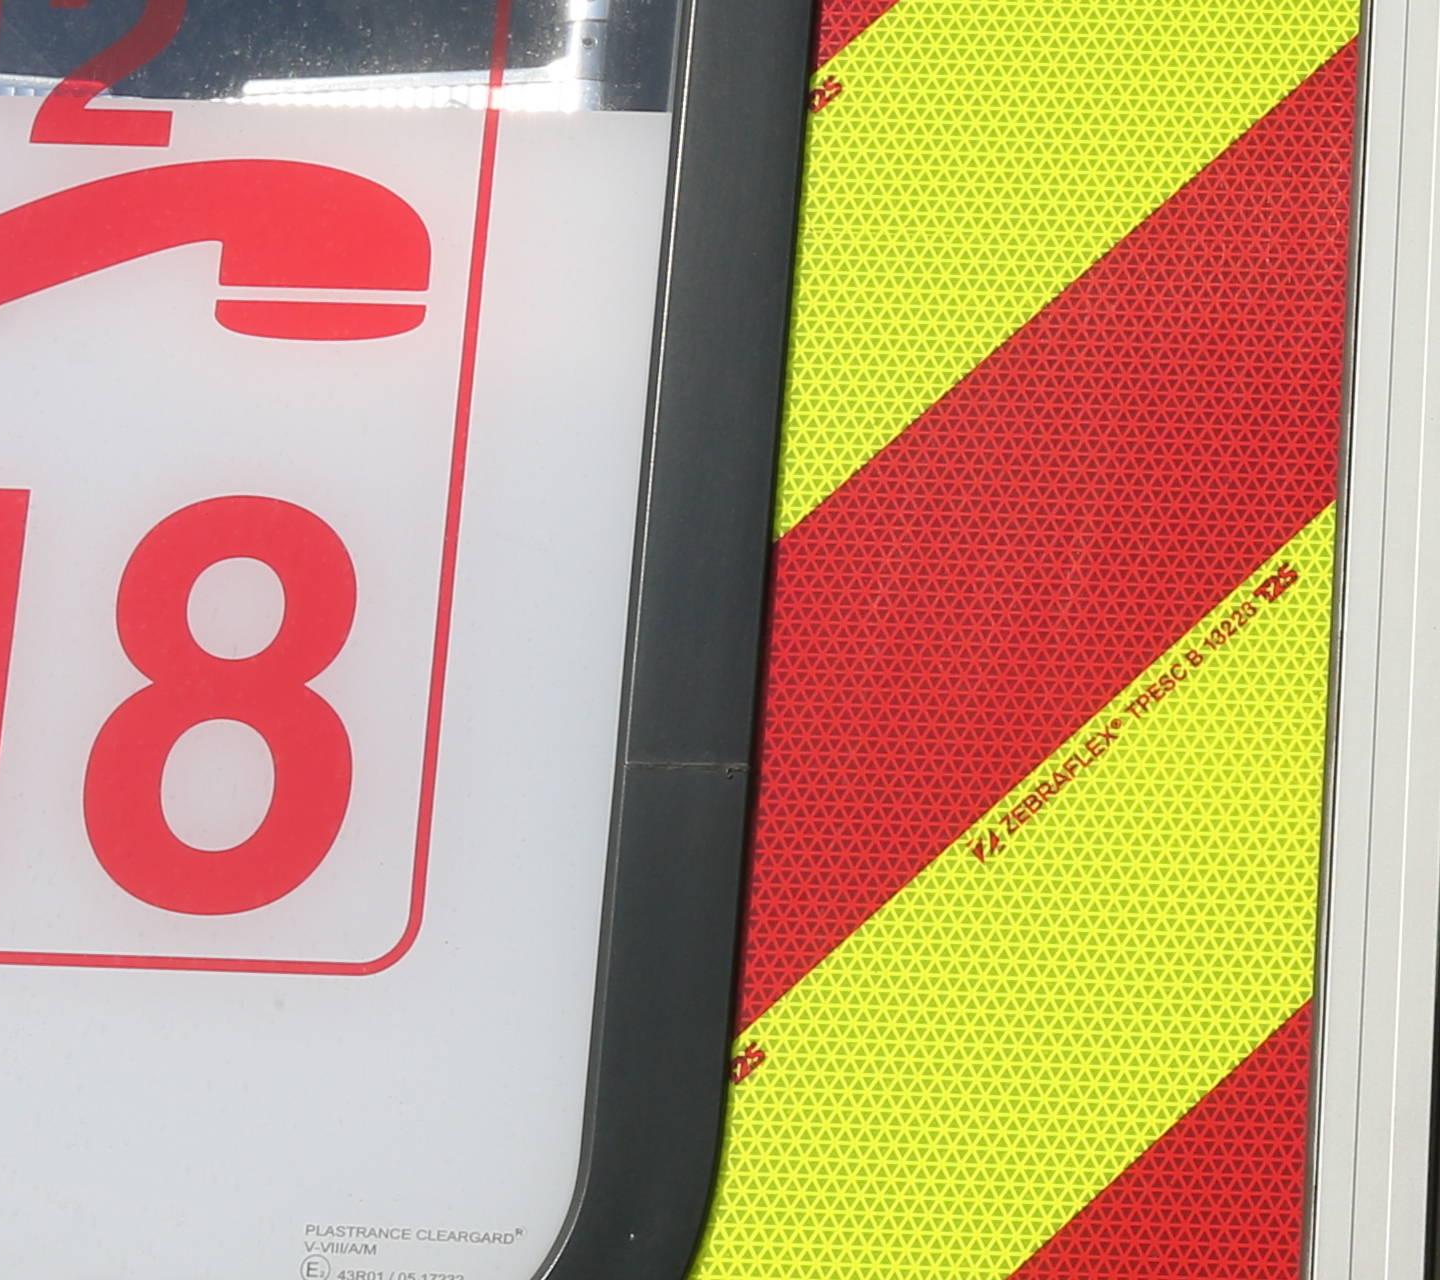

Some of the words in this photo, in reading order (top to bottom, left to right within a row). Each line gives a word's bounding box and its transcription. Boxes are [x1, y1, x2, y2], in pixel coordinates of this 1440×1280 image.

[1125, 662, 1187, 720] TPESC
[1184, 647, 1205, 669] B
[1202, 599, 1258, 651] 13223
[304, 1224, 412, 1241] PLASTRANCE
[304, 1241, 377, 1256] V-VIII/A/M
